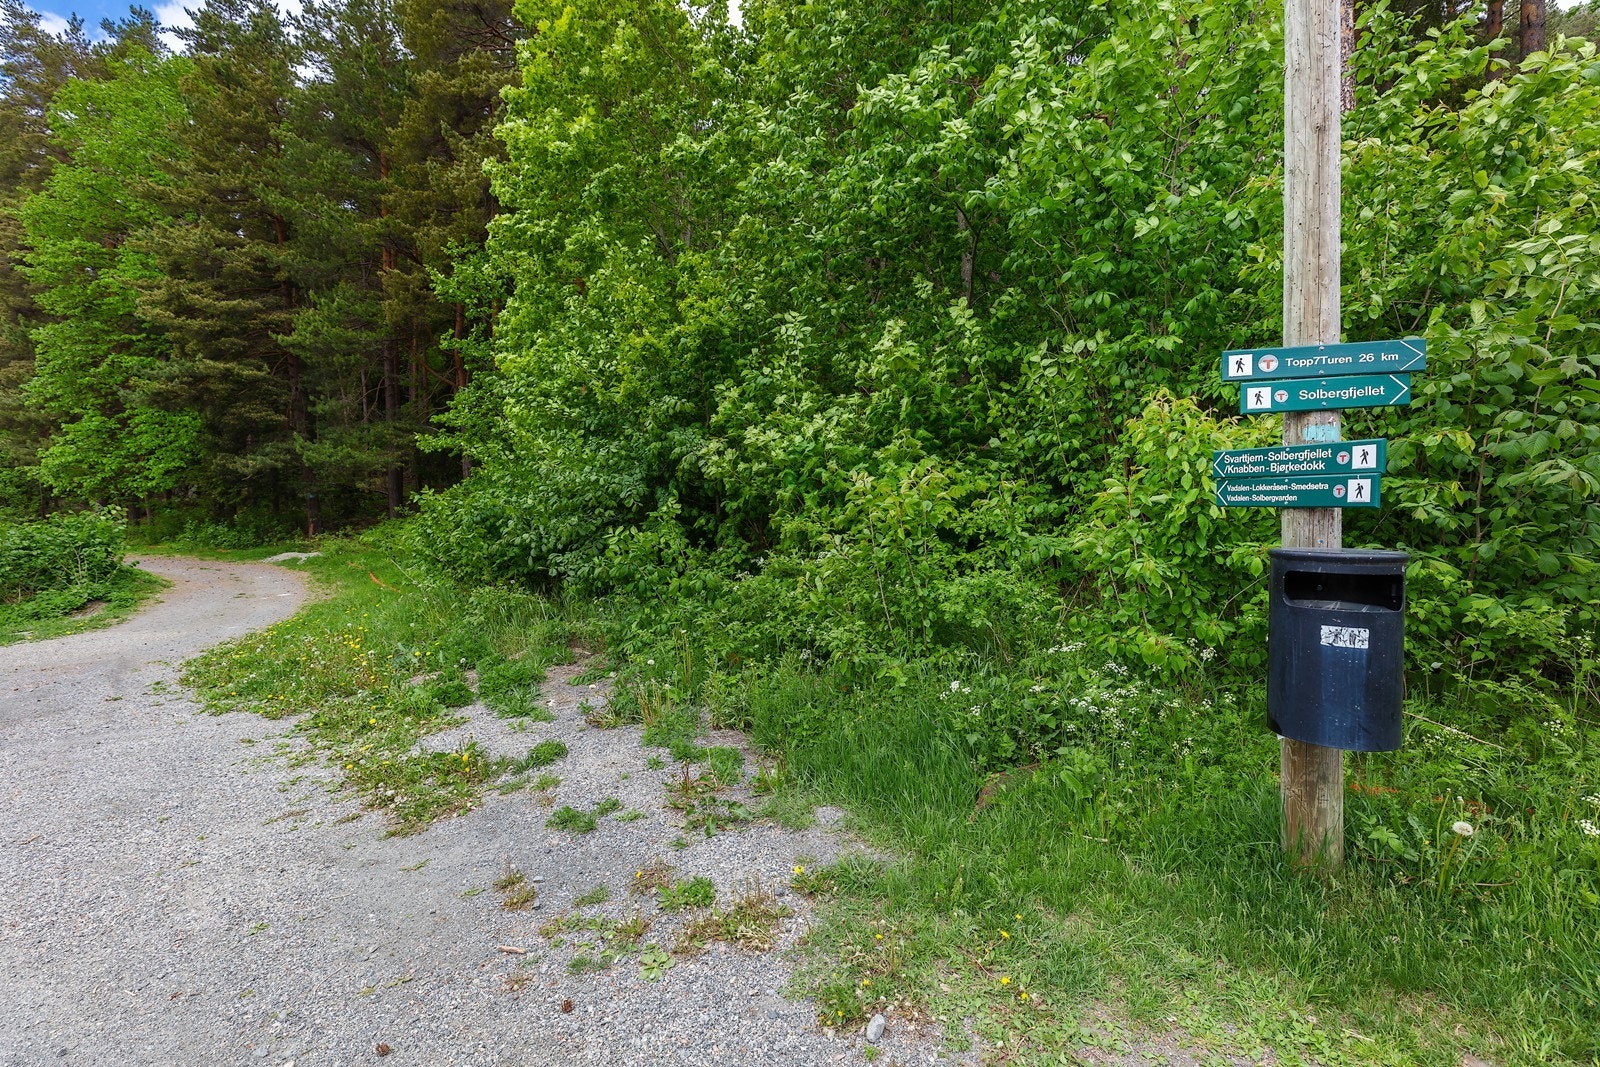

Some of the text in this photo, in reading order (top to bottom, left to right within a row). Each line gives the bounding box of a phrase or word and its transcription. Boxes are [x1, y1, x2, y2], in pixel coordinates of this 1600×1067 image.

[1358, 353, 1375, 363] 26
[1381, 352, 1399, 361] km
[1299, 385, 1385, 401] Solbergfjellet
